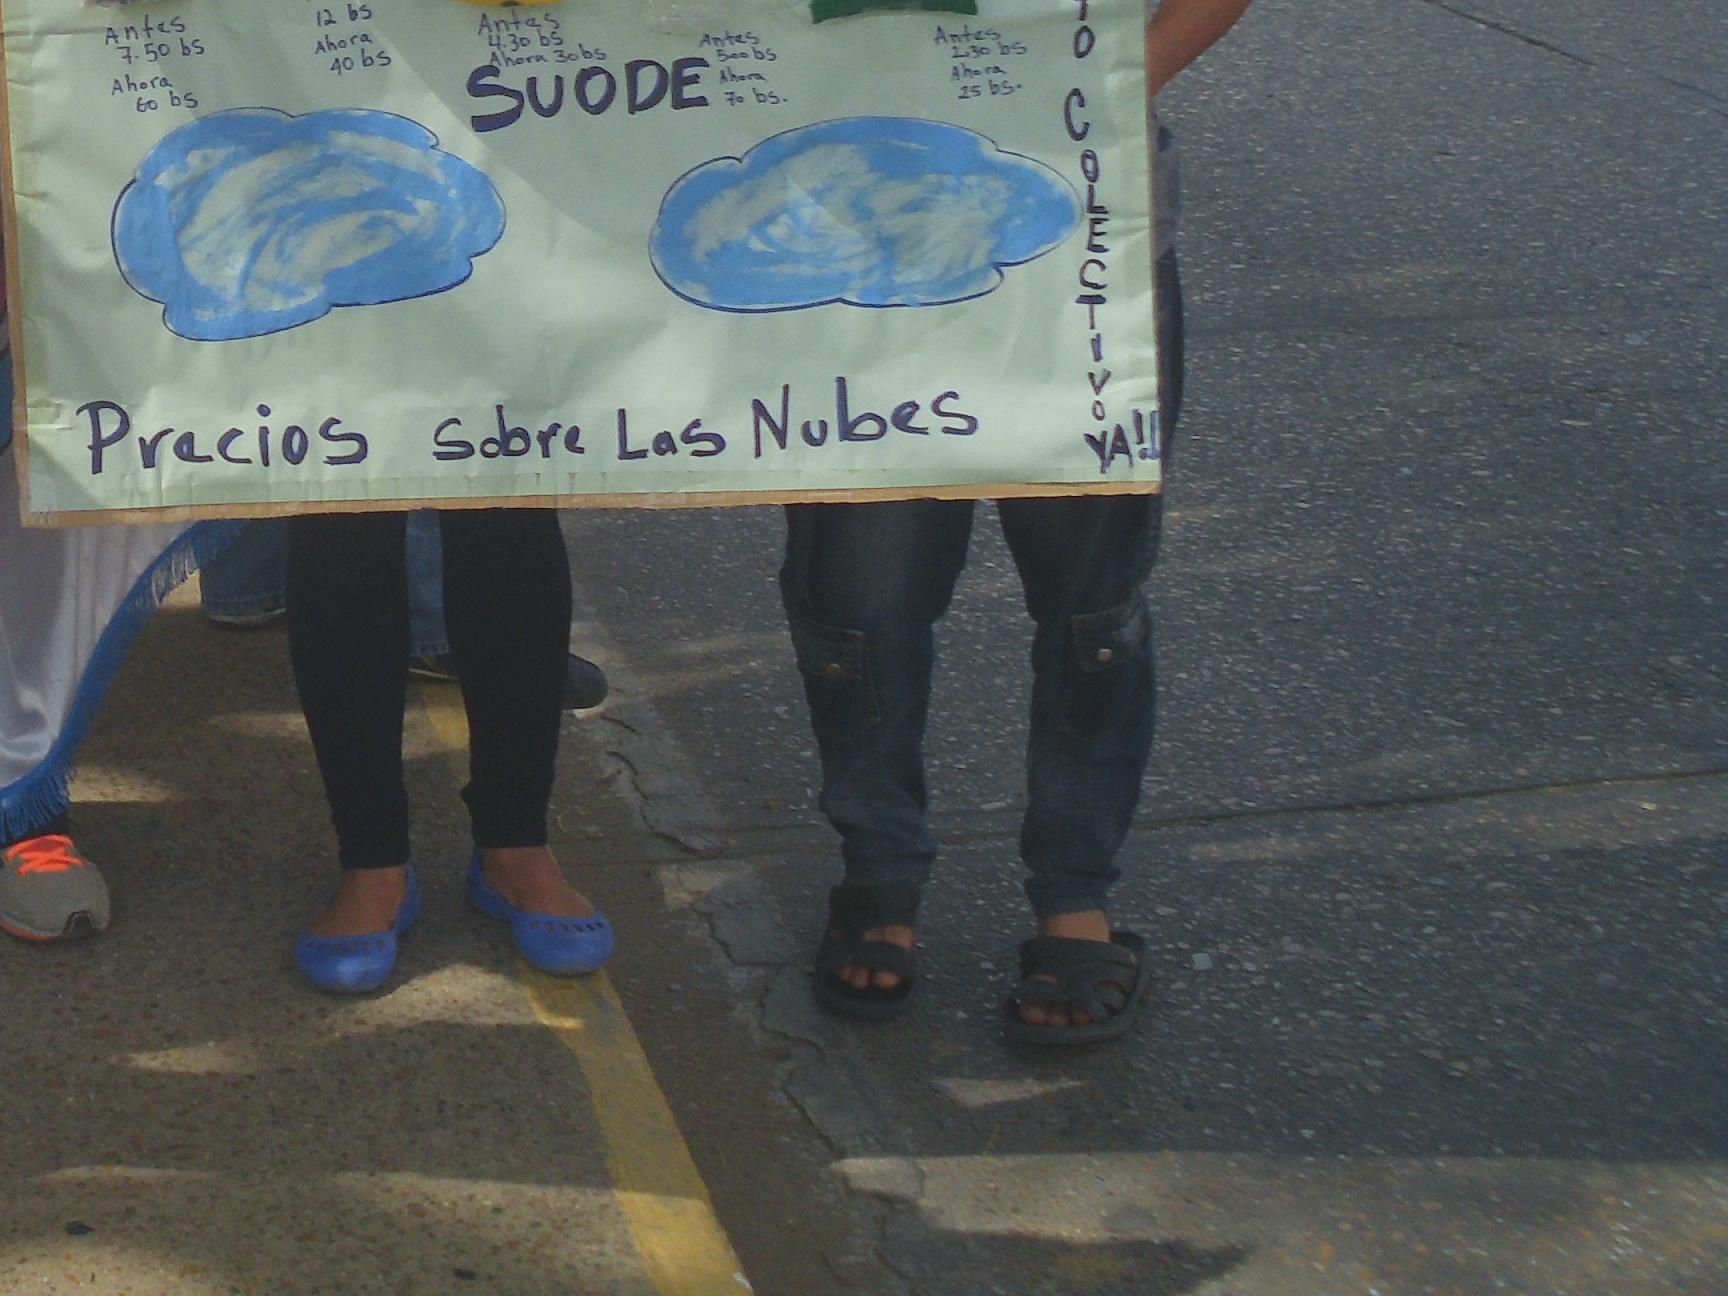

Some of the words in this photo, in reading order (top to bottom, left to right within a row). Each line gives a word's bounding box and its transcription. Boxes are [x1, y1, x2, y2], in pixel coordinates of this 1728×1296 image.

[316, 8, 336, 27] 12
[478, 10, 561, 35] Antes
[105, 15, 186, 45] Antes
[699, 32, 761, 48] Antes
[934, 25, 1001, 44] Antes
[315, 32, 372, 54] Ahora
[488, 33, 531, 52] 4.30
[117, 43, 170, 65] 7.50
[489, 46, 547, 67] Ahora
[330, 56, 354, 75] 40
[719, 66, 768, 84] Ahora
[950, 62, 1006, 81] Ahora
[112, 74, 172, 96] Ahora
[467, 57, 710, 132] SUODE
[136, 97, 159, 113] 60
[1064, 87, 1112, 422] COLECTIVO
[76, 401, 368, 474] Precios
[617, 407, 726, 460] Las
[751, 376, 979, 458] Nubes
